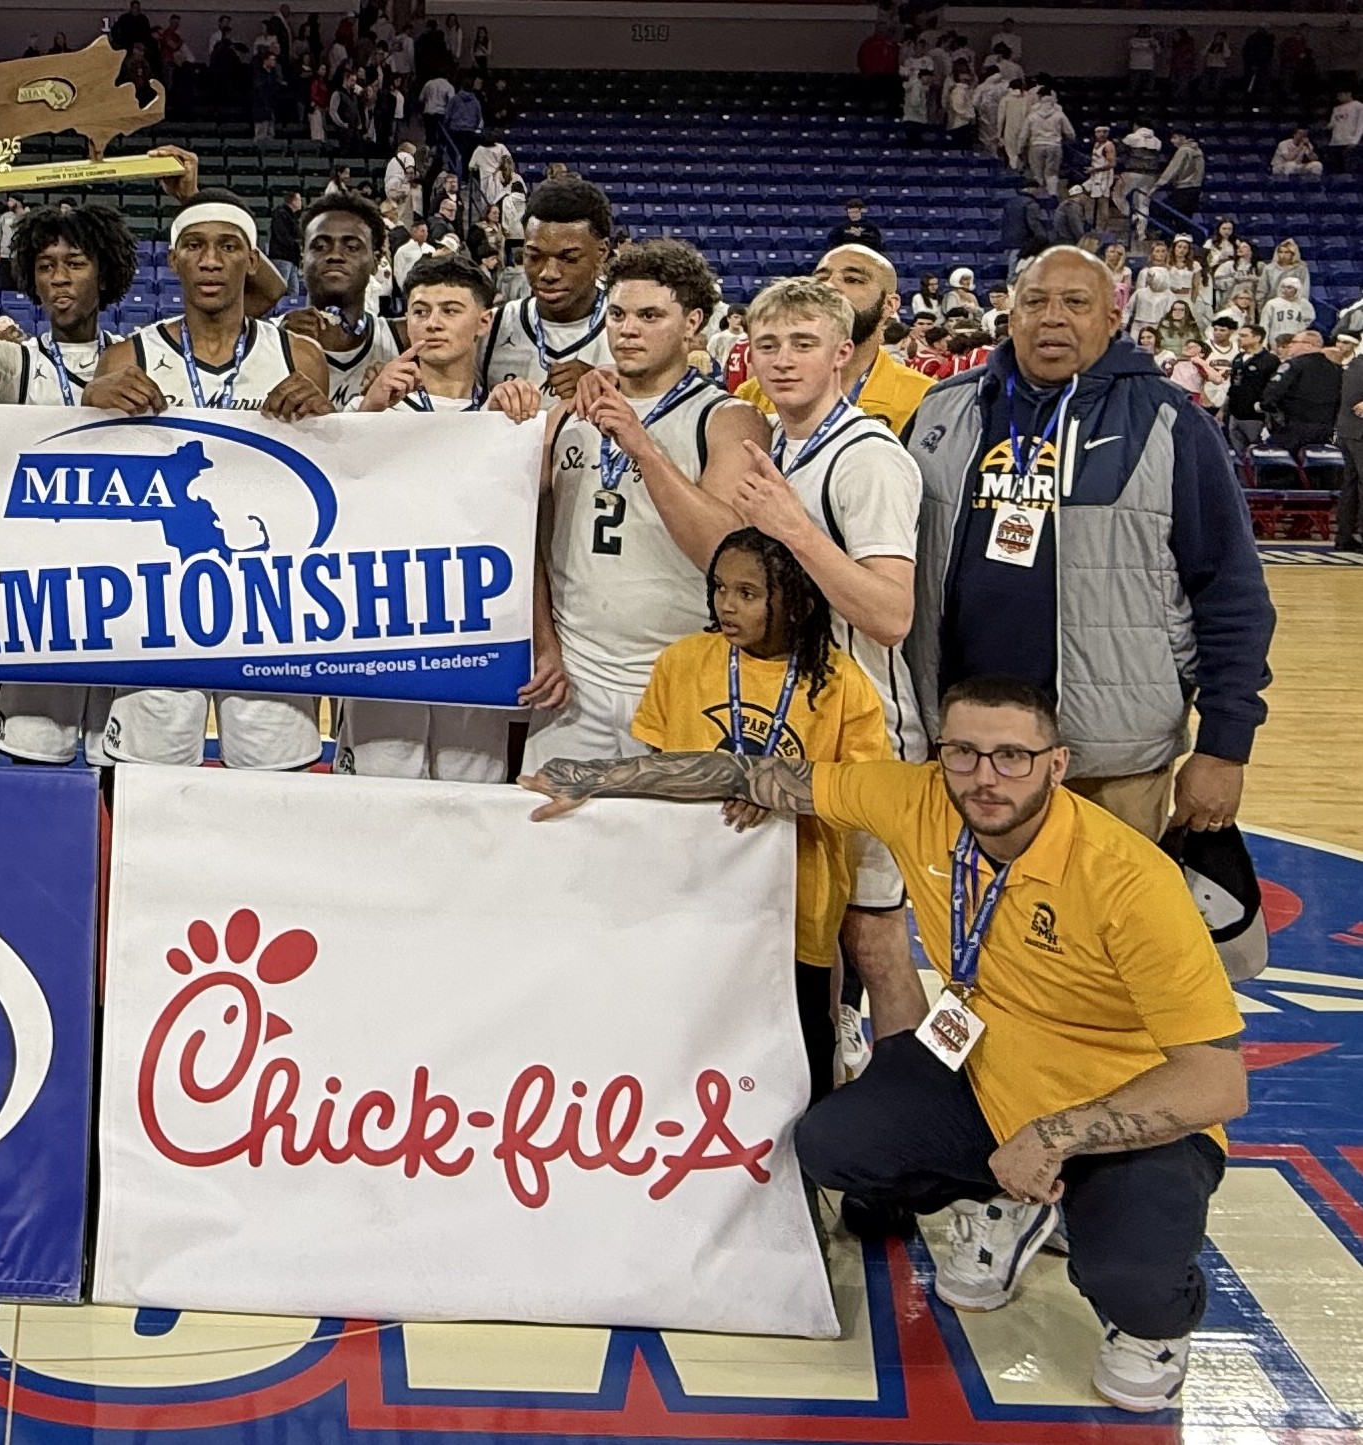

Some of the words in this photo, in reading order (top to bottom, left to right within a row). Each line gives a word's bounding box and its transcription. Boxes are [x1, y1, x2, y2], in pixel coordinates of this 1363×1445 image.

[631, 24, 670, 41] 119
[1276, 310, 1303, 323] USA
[560, 445, 585, 471] St.
[21, 467, 177, 508] MIAA
[592, 490, 627, 556] 2
[242, 662, 312, 678] Growing
[315, 656, 417, 676] Courageous
[1031, 919, 1058, 945] SMH
